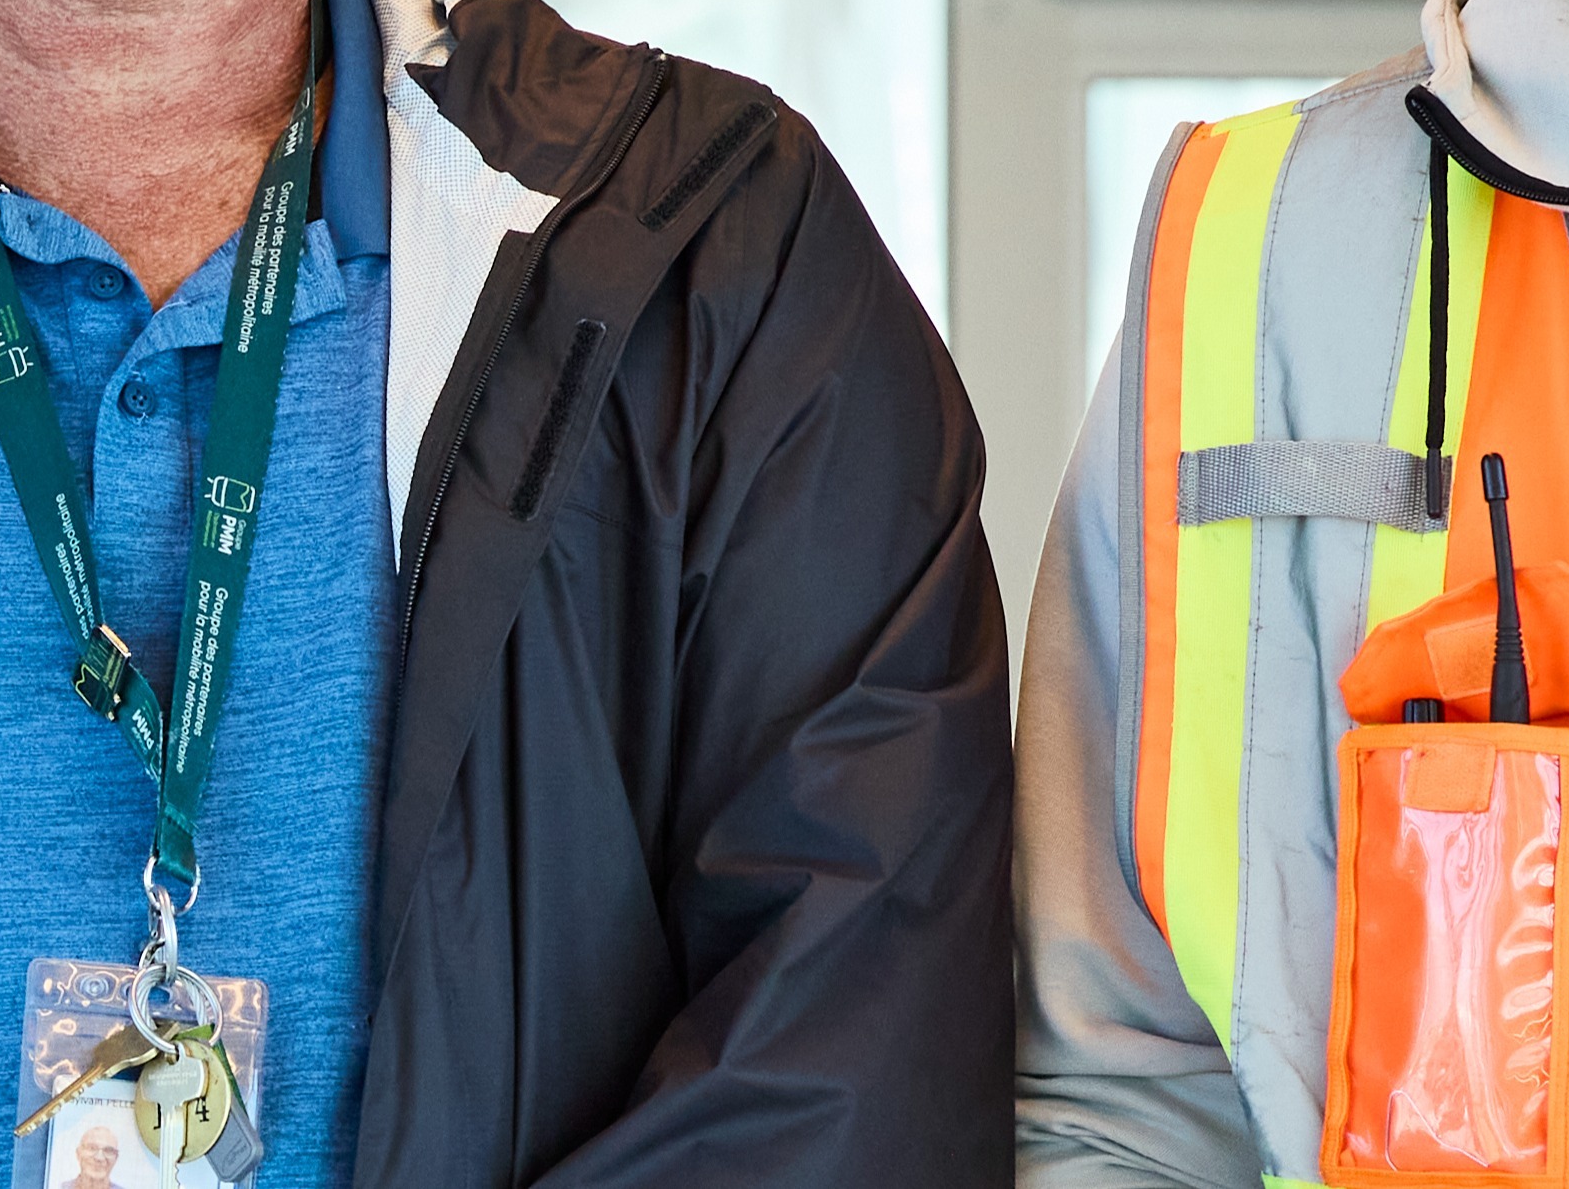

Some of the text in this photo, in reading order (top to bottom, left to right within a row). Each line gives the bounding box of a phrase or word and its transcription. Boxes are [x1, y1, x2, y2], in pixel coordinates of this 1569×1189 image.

[283, 121, 299, 157] PMM
[272, 225, 286, 247] des
[275, 181, 294, 224] Groupe
[237, 185, 275, 354] pour la mobilité métropolitaine
[262, 248, 281, 315] partenaires
[55, 492, 86, 583] métropolitaine
[218, 514, 237, 555] PMM
[55, 542, 85, 616] partenaires
[176, 580, 211, 774] pour la mobilité métropolitaine
[194, 587, 229, 737] Groupe des partenaires
[132, 709, 154, 750] PMM
